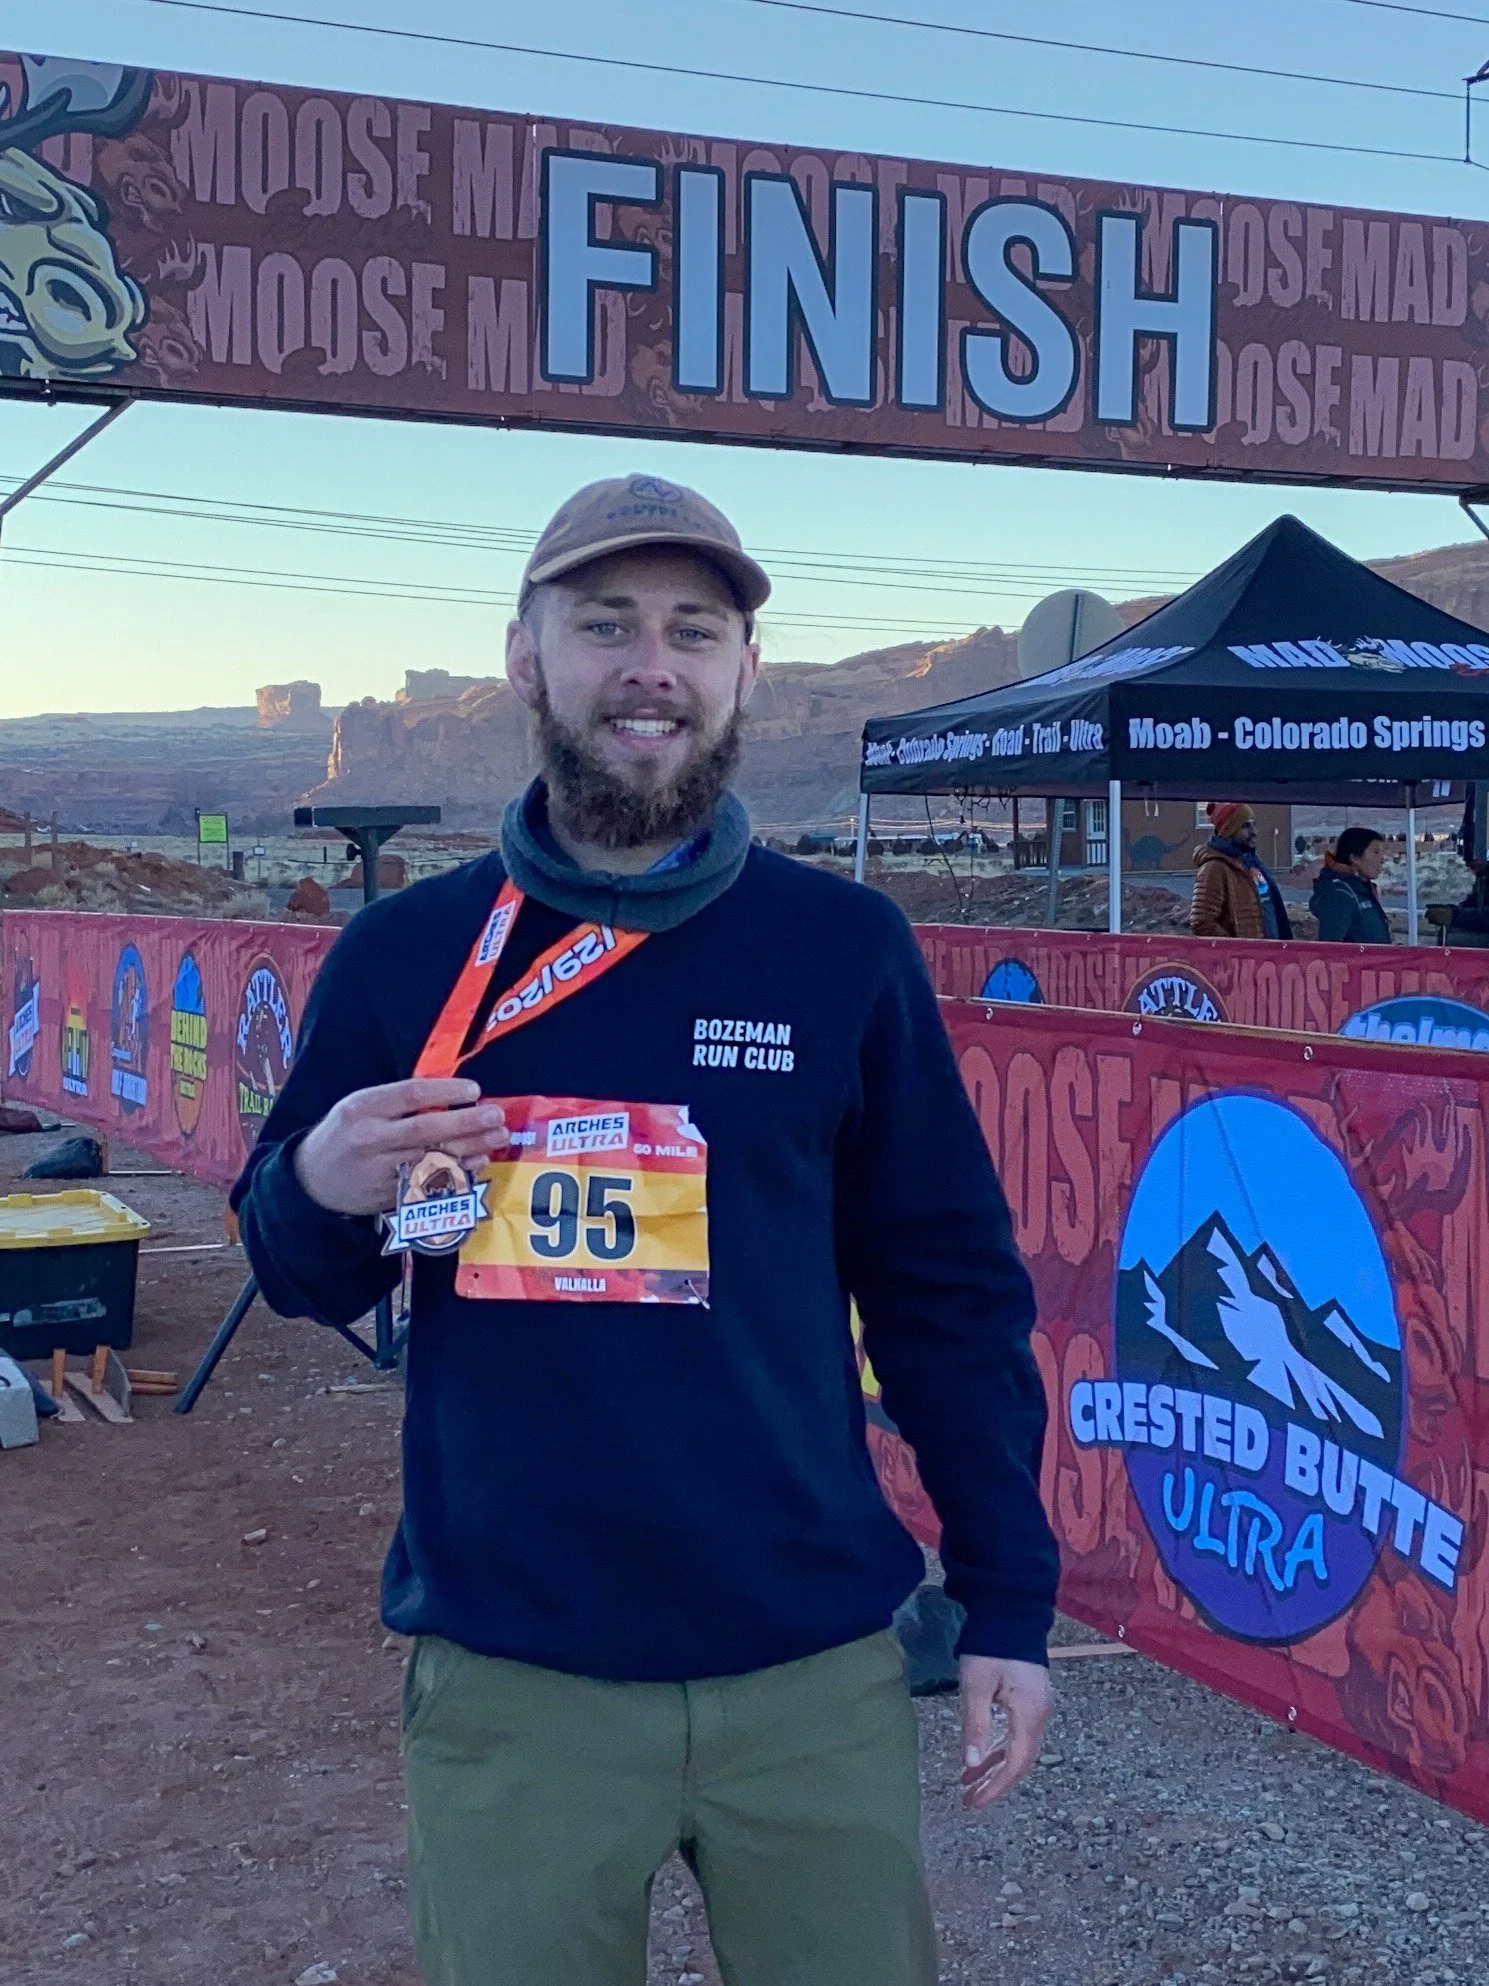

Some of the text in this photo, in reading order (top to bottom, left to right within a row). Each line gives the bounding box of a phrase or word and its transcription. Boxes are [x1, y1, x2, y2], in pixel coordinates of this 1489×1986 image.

[170, 79, 432, 227] MOOSE
[541, 147, 1219, 433] FINISH
[1341, 218, 1469, 328] MAD
[185, 243, 447, 381] MOOSE
[1349, 354, 1479, 461] MAD
[1226, 634, 1351, 669] MAD
[1032, 721, 1062, 754] Trail
[1069, 719, 1104, 752] Ultra
[1128, 717, 1212, 750] Moab
[1234, 716, 1368, 750] Colorado
[1373, 715, 1486, 751] Springs
[693, 1018, 792, 1046] BOZEMAN
[692, 1044, 795, 1072] RUN CLUB
[550, 1132, 625, 1152] ULTRA
[552, 1116, 625, 1136] ARCHES
[404, 1198, 471, 1221] ARCHES
[404, 1213, 472, 1236] ULTRA
[528, 1170, 637, 1261] 95
[553, 1276, 608, 1293] VALHALLA
[1069, 1380, 1270, 1472] CRESTED
[1284, 1422, 1464, 1589] BUTTE
[1162, 1466, 1328, 1592] ULTRA
